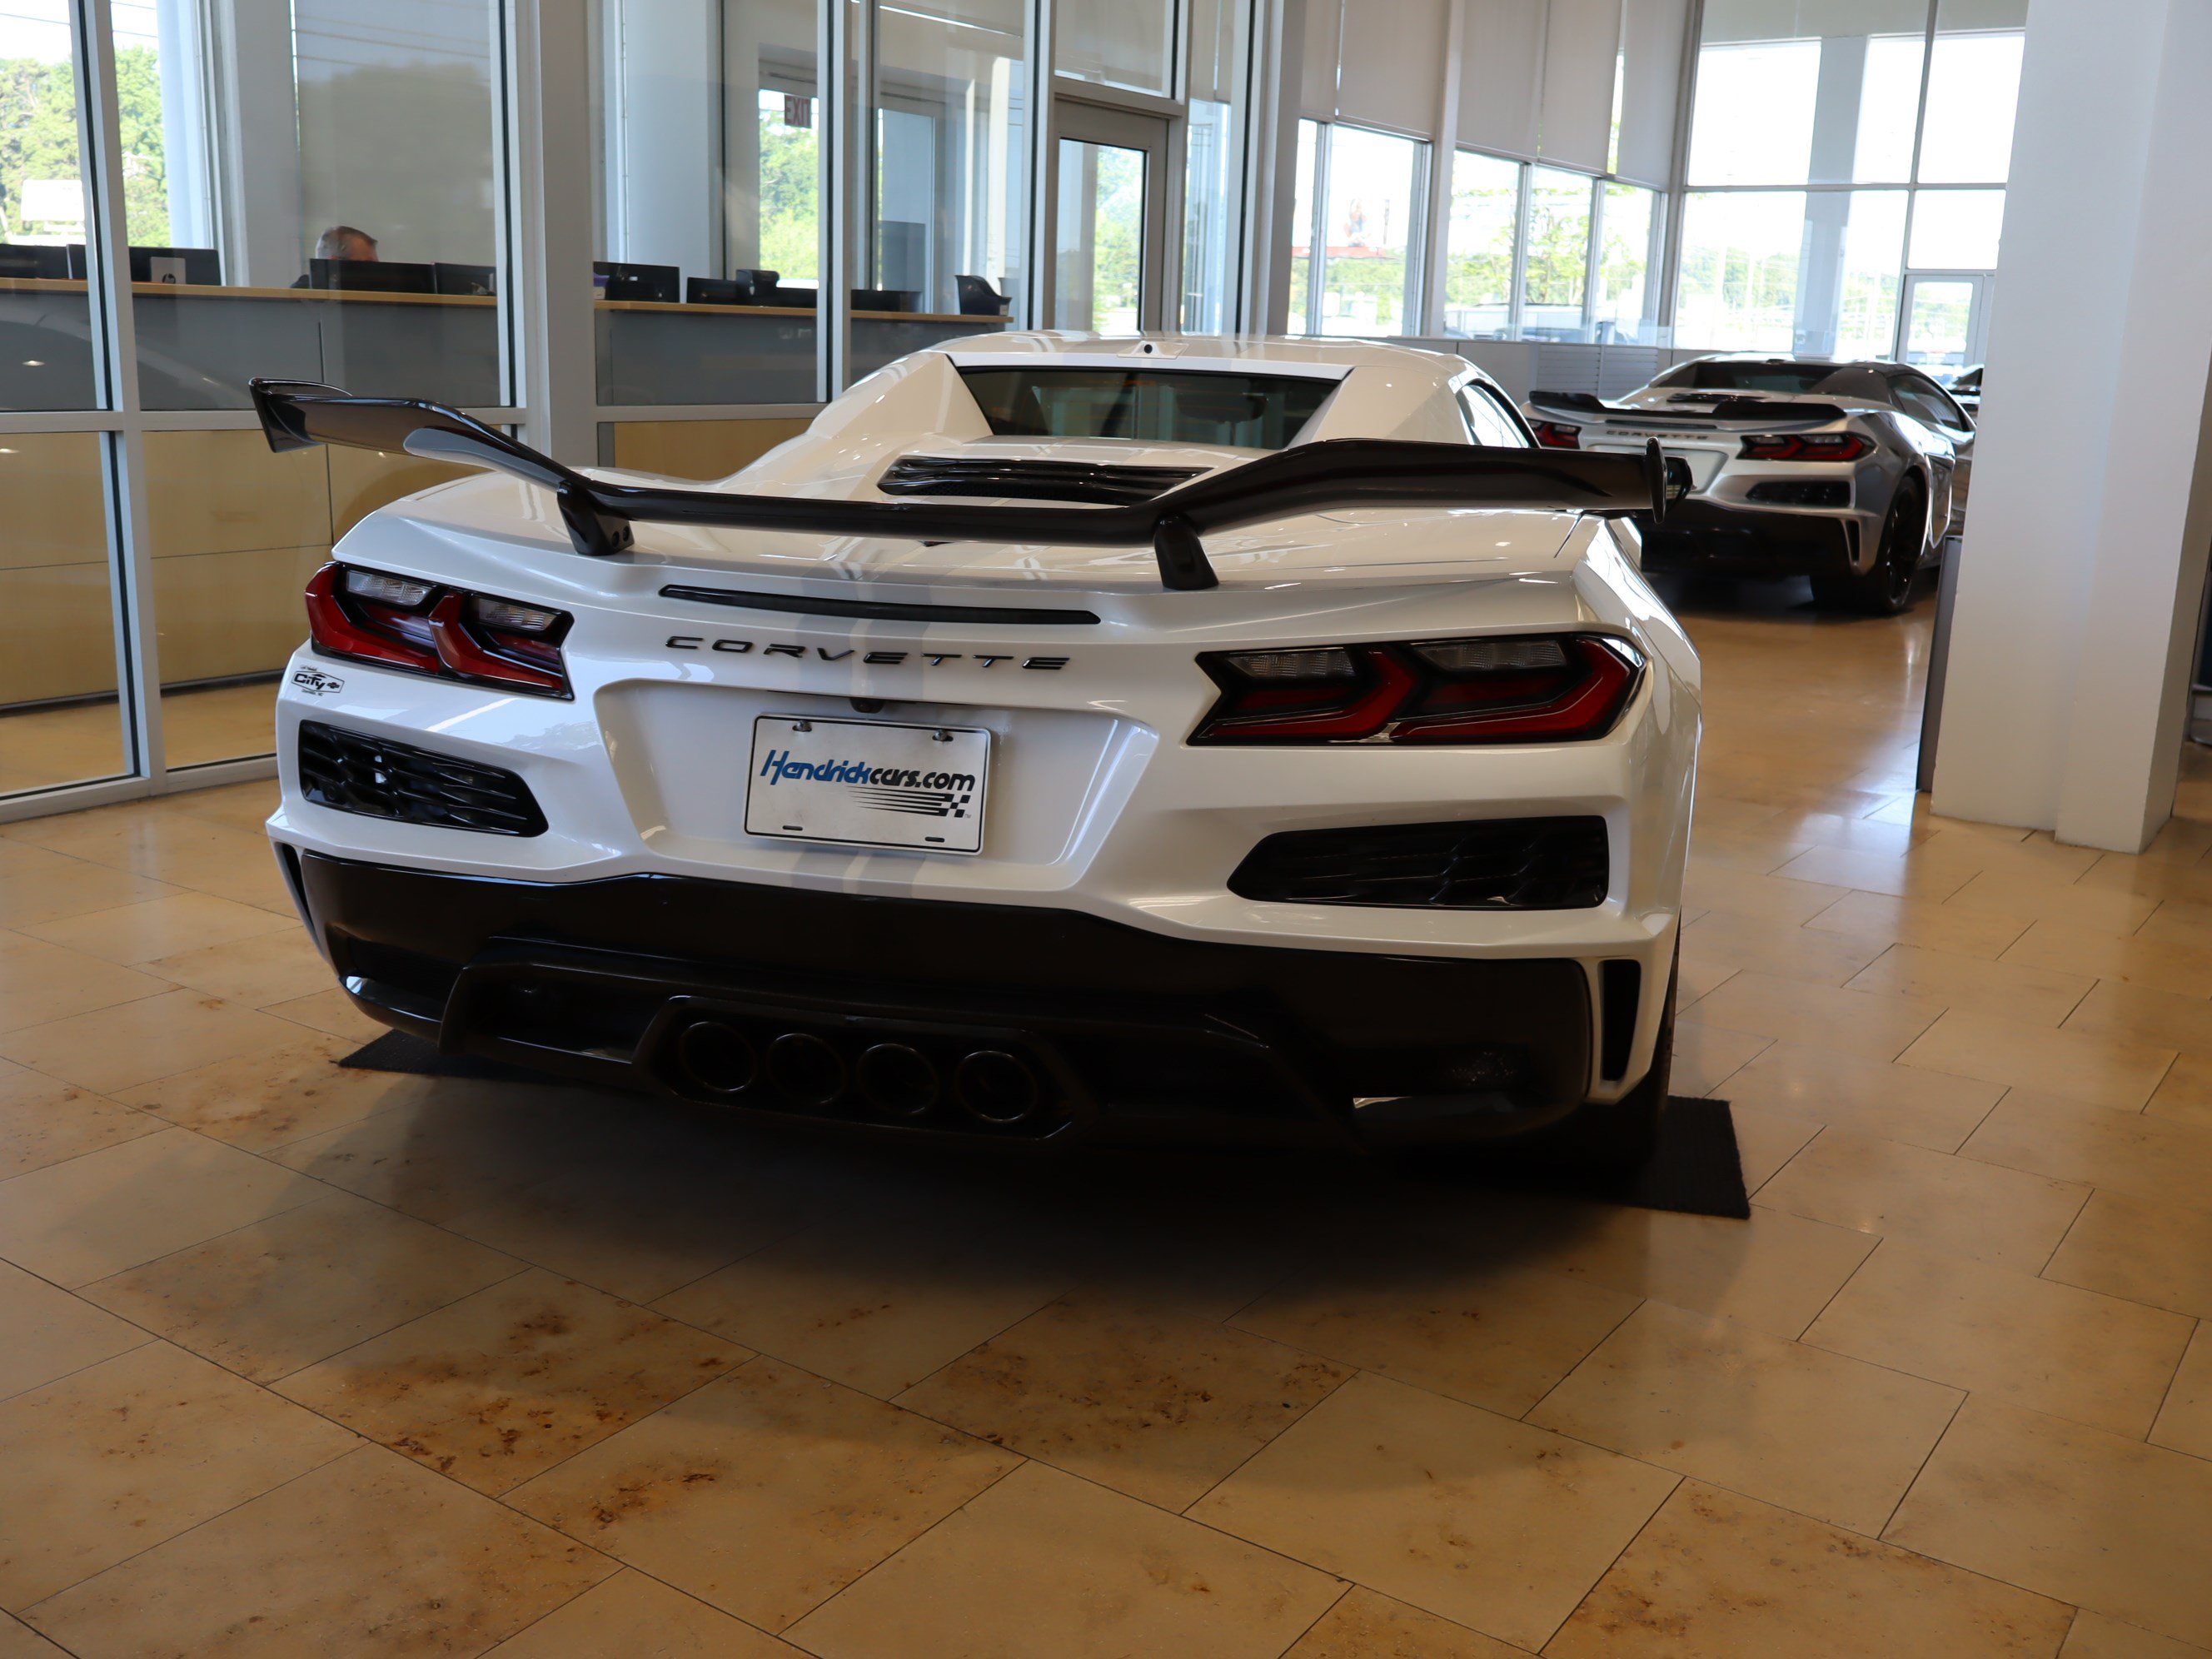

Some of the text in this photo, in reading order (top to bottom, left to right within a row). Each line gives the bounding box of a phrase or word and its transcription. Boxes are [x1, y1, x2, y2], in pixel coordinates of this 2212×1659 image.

[1606, 430, 1708, 440] CORVETTE
[665, 635, 1071, 670] CORVETTE
[760, 750, 975, 792] Hendrickcars.com
